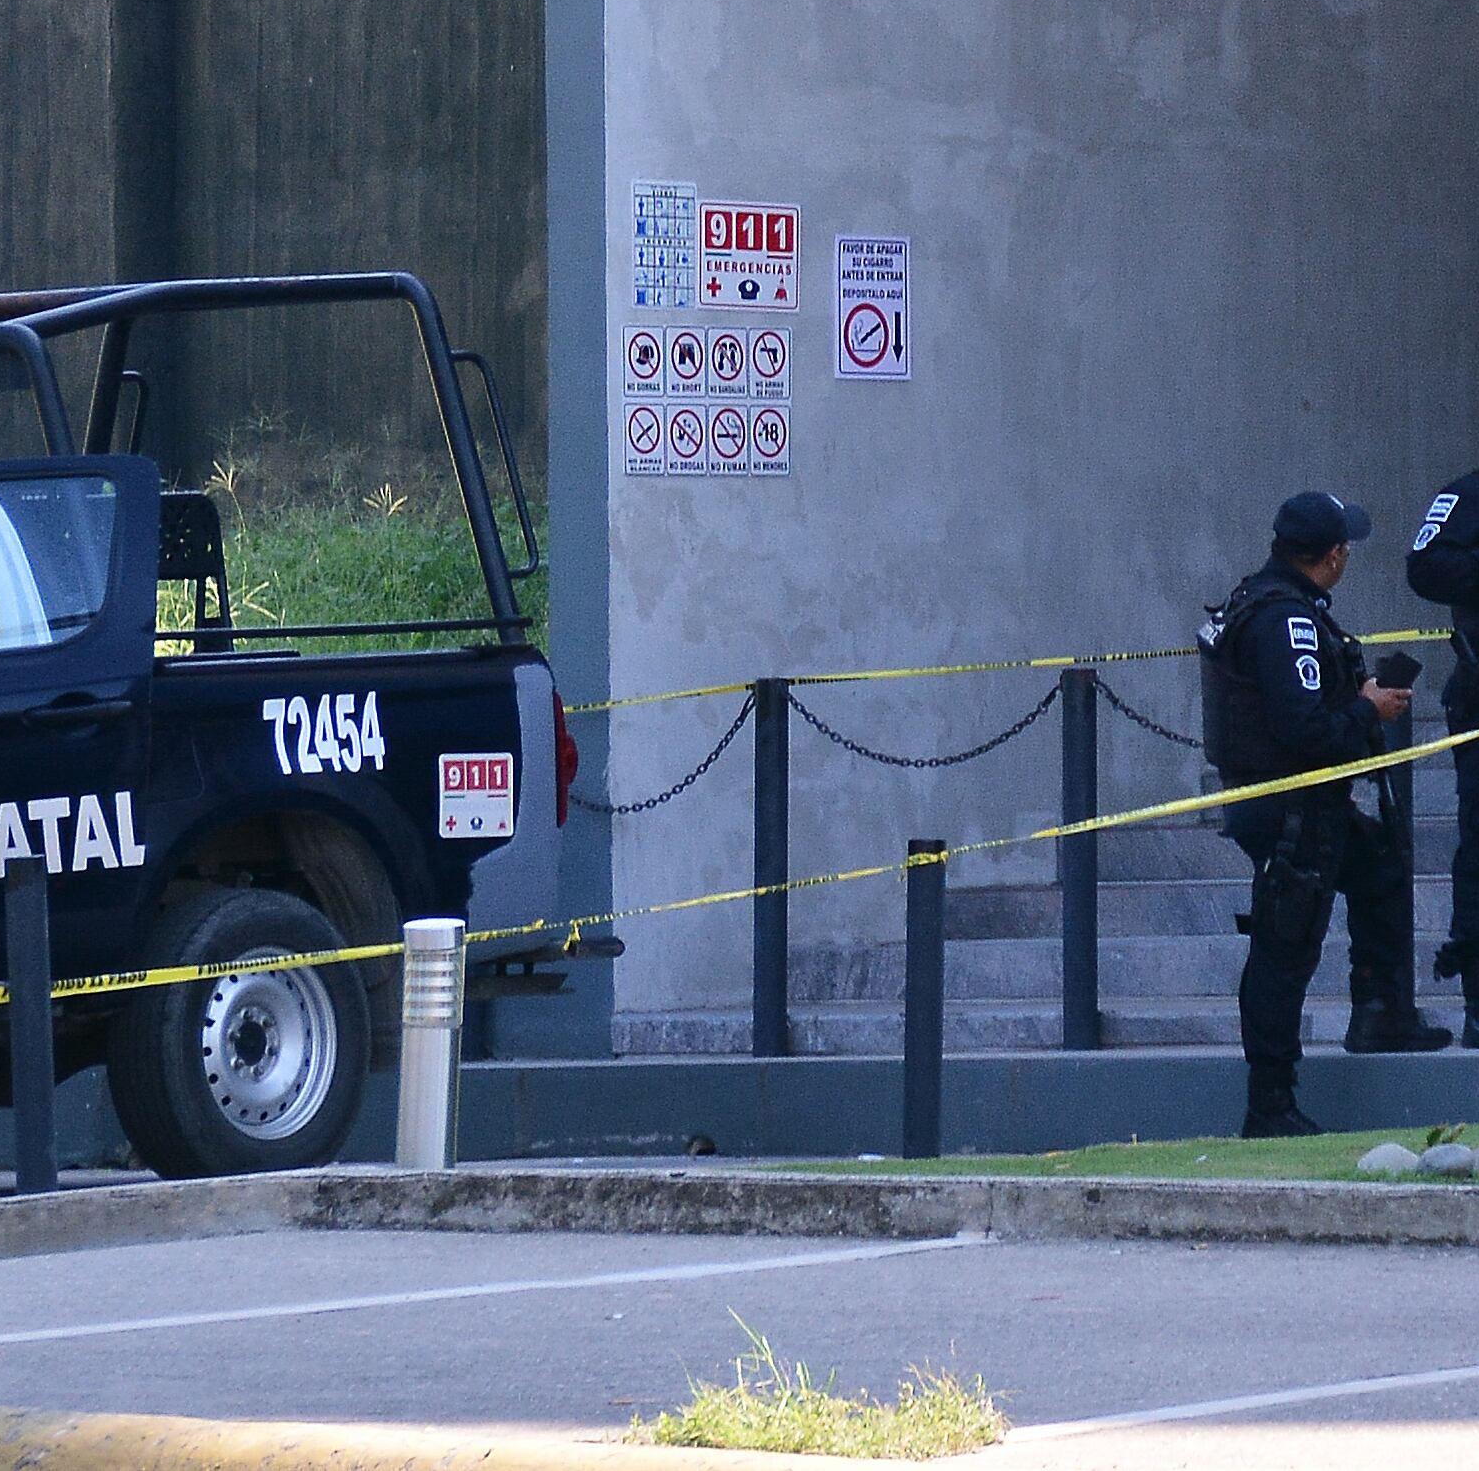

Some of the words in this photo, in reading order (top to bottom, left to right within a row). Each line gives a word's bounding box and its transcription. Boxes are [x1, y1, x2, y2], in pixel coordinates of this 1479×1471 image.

[710, 213, 788, 250] 911
[842, 243, 864, 254] FAVOR
[866, 243, 875, 254] DE
[876, 244, 903, 255] APAGAR
[706, 260, 793, 276] EMERGENCIAS
[852, 257, 862, 267] SU
[863, 257, 893, 268] CIGARRO
[842, 269, 864, 280] ANTES
[866, 270, 875, 281] DE
[876, 270, 903, 281] ENTRAR
[669, 461, 679, 469] NO
[680, 461, 705, 470] DROGAS
[711, 461, 721, 470] NO
[723, 461, 747, 471] FUMAR
[753, 461, 762, 470] NO
[262, 690, 386, 775] 72454
[448, 764, 502, 787] 911
